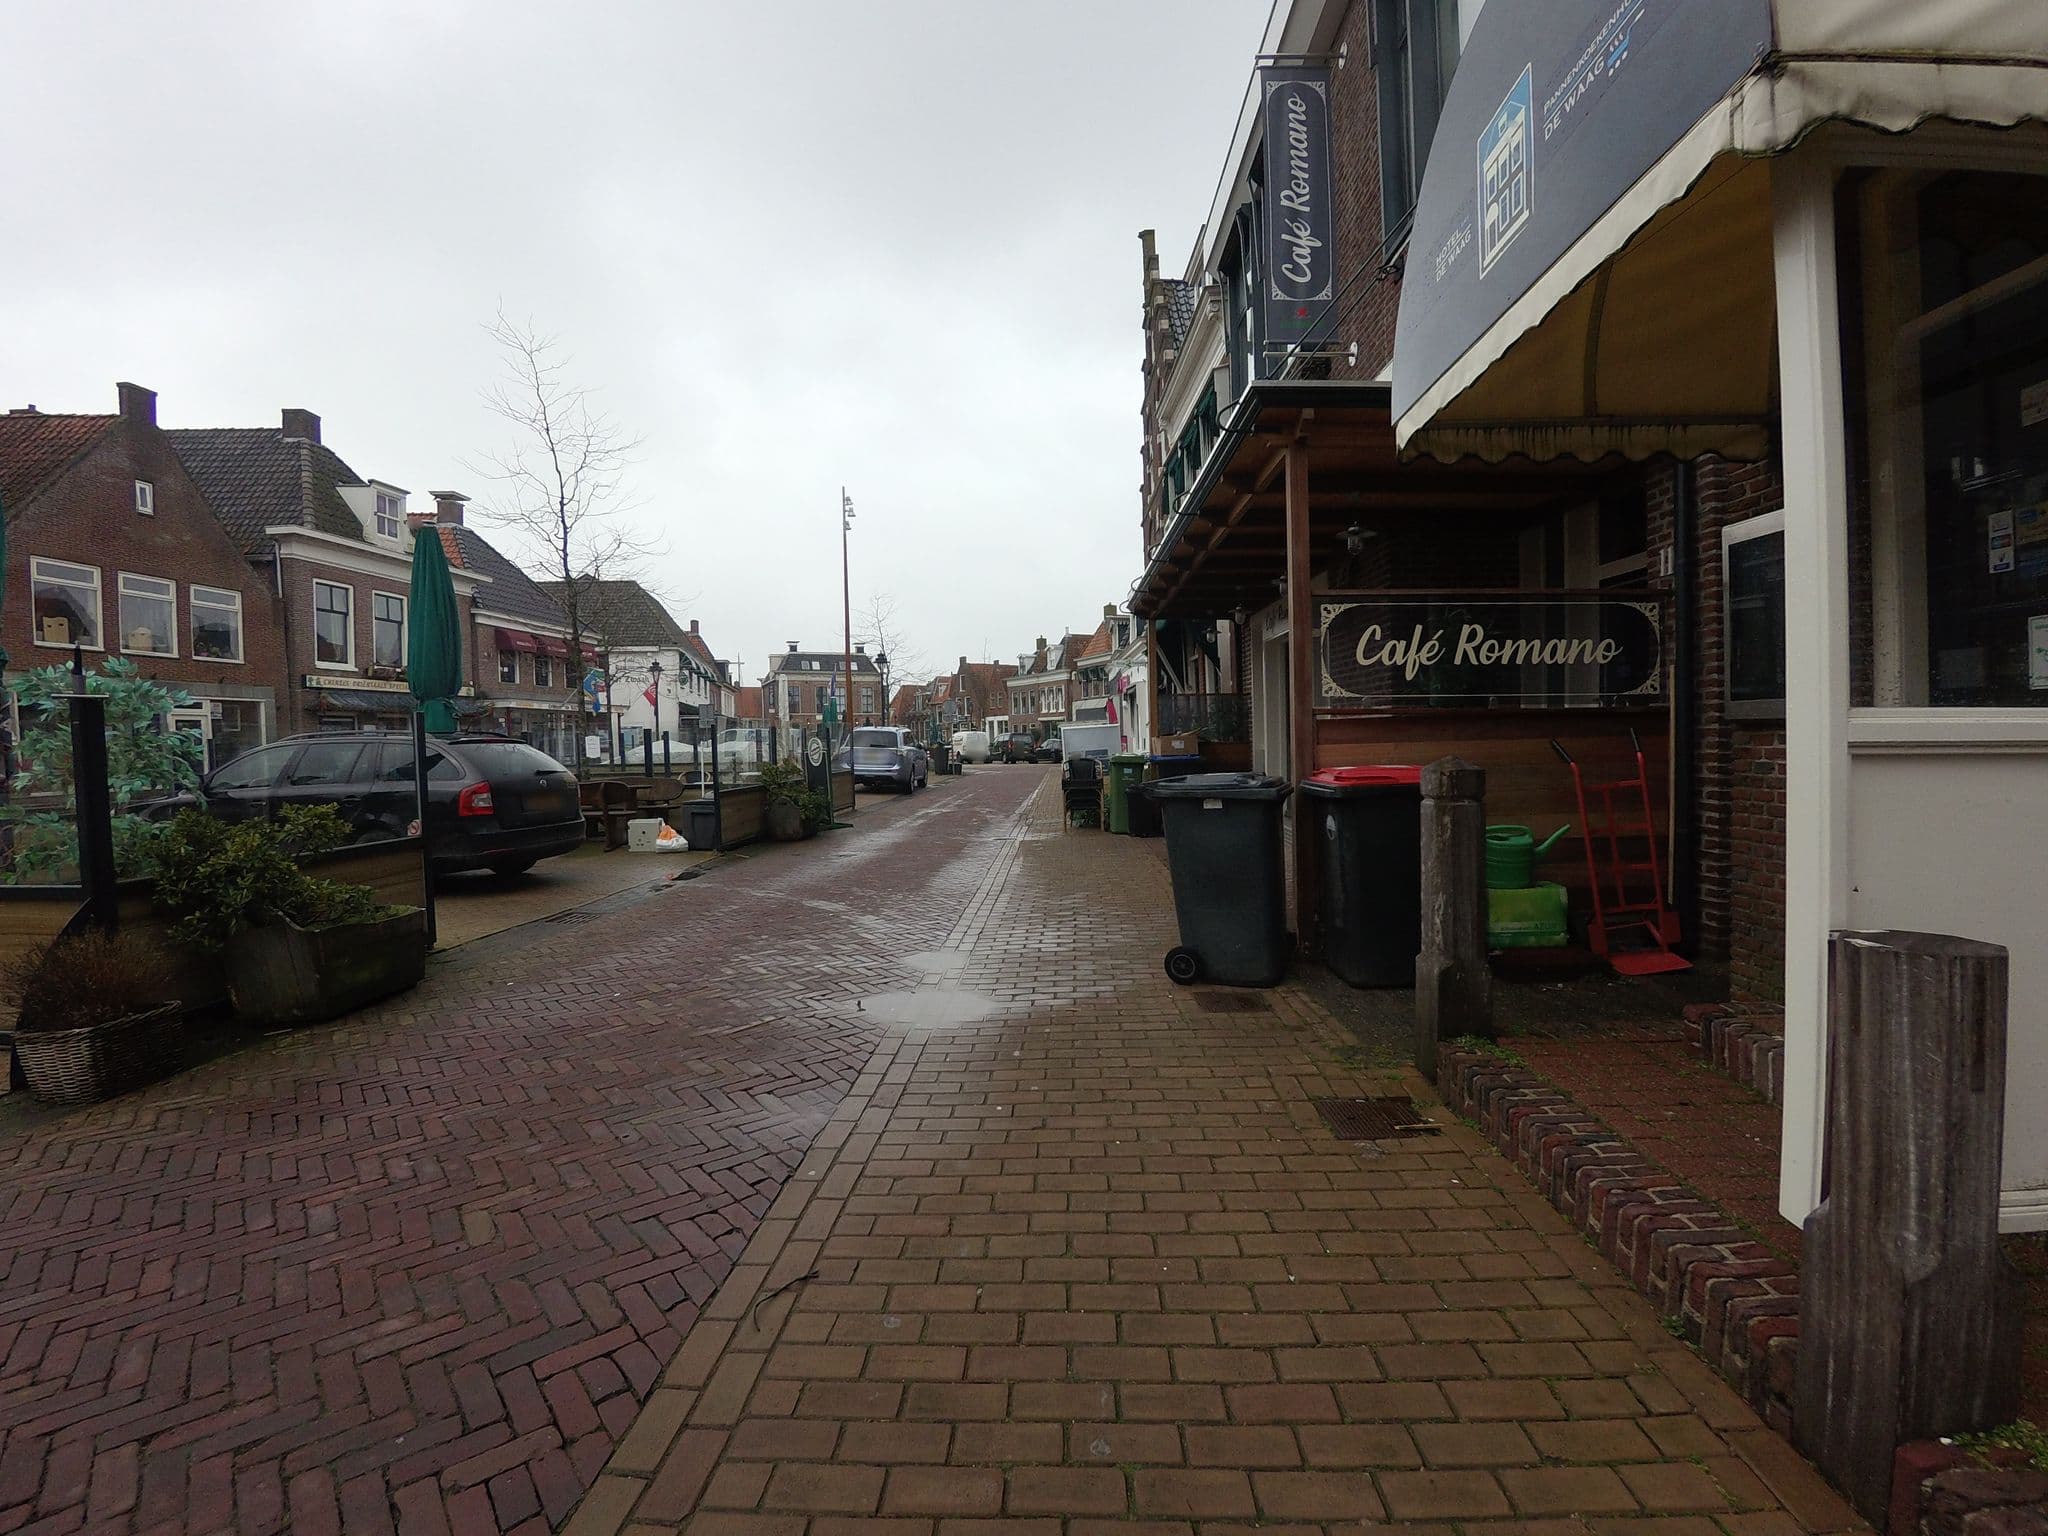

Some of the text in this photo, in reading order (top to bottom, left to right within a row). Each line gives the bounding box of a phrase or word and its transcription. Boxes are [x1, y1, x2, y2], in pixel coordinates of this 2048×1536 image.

[1544, 55, 1605, 141] DE WAAG
[1280, 91, 1311, 213] Romano
[1280, 217, 1323, 283] Café
[1436, 228, 1462, 267] HOTEL
[1436, 229, 1472, 282] DE WAAG
[1356, 623, 1624, 681] Café Romano
